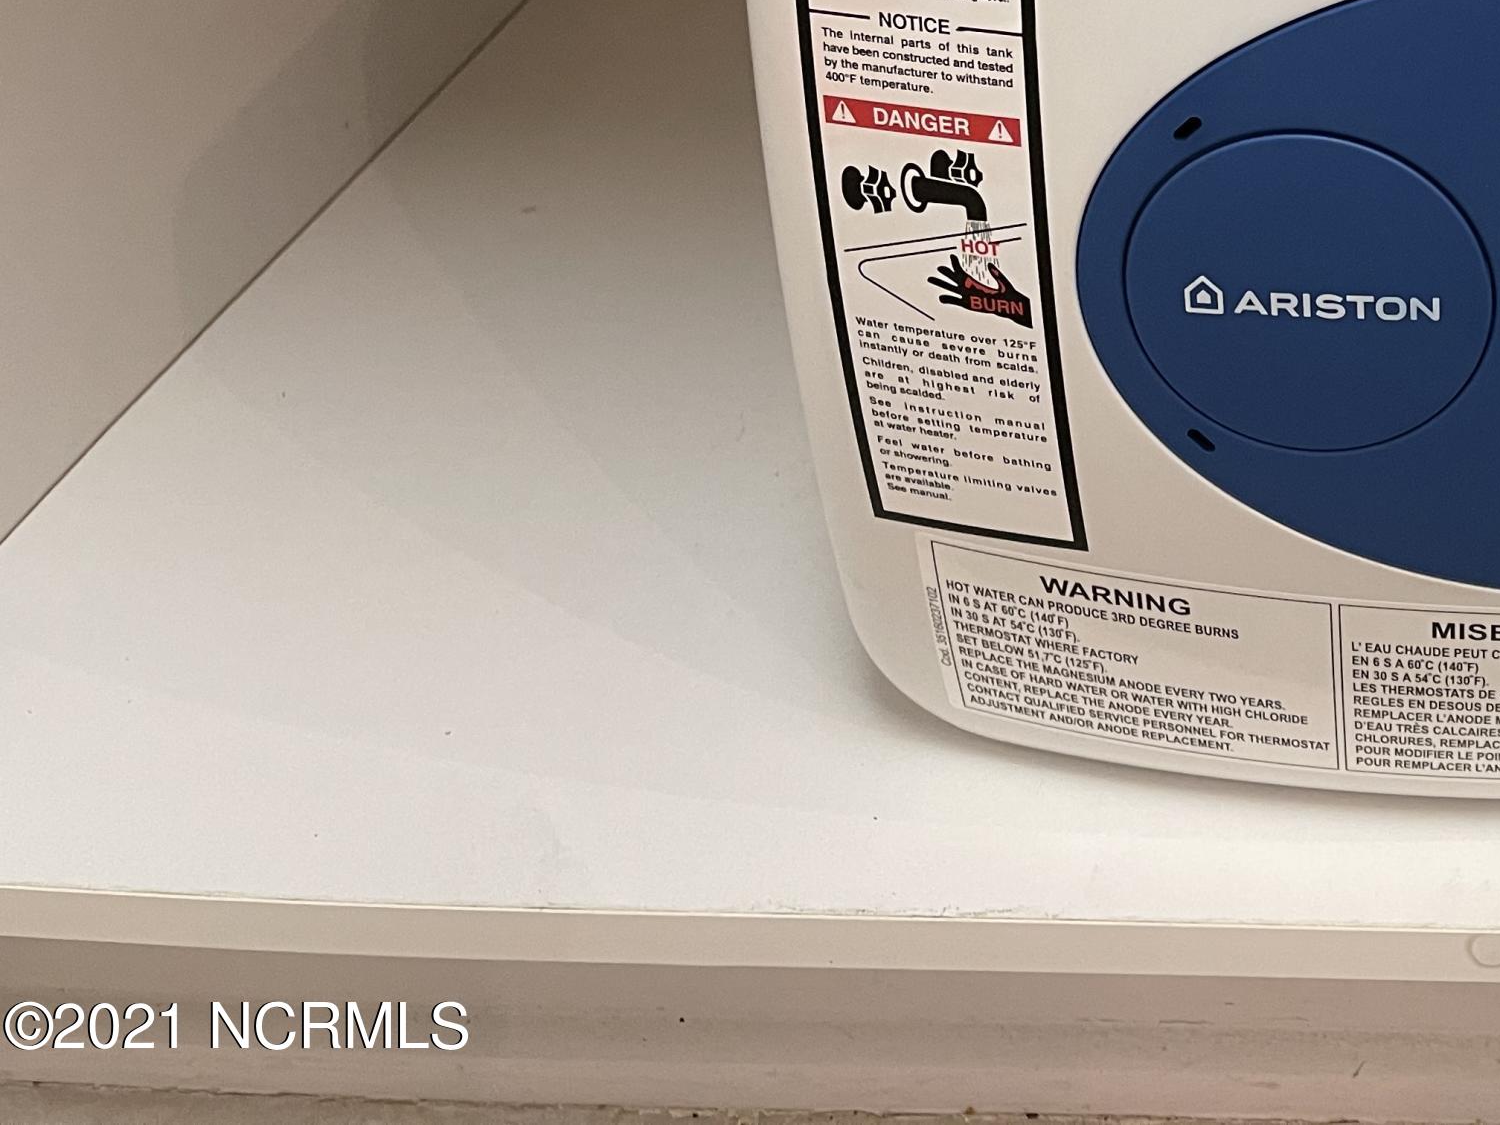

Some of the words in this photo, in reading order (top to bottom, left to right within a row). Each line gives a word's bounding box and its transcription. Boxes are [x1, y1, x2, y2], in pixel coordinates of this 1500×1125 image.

[879, 12, 950, 35] NOTICE
[874, 107, 969, 135] DANGER
[960, 239, 1000, 256] HOT
[970, 296, 1024, 315] BURN
[1235, 291, 1439, 321] ARISTON
[1040, 576, 1191, 615] WARNING
[946, 580, 969, 593] HOT
[974, 586, 1015, 604] WATER
[1019, 595, 1044, 609] CAN
[1048, 600, 1108, 621] PRODUCE
[1112, 612, 1135, 624] 3RD
[1140, 616, 1191, 633] DEGREE
[1195, 625, 1238, 639] BURNS
[1365, 643, 1391, 654] EAU
[1396, 645, 1450, 657] CHAUDE
[1454, 649, 1488, 658] PEUT
